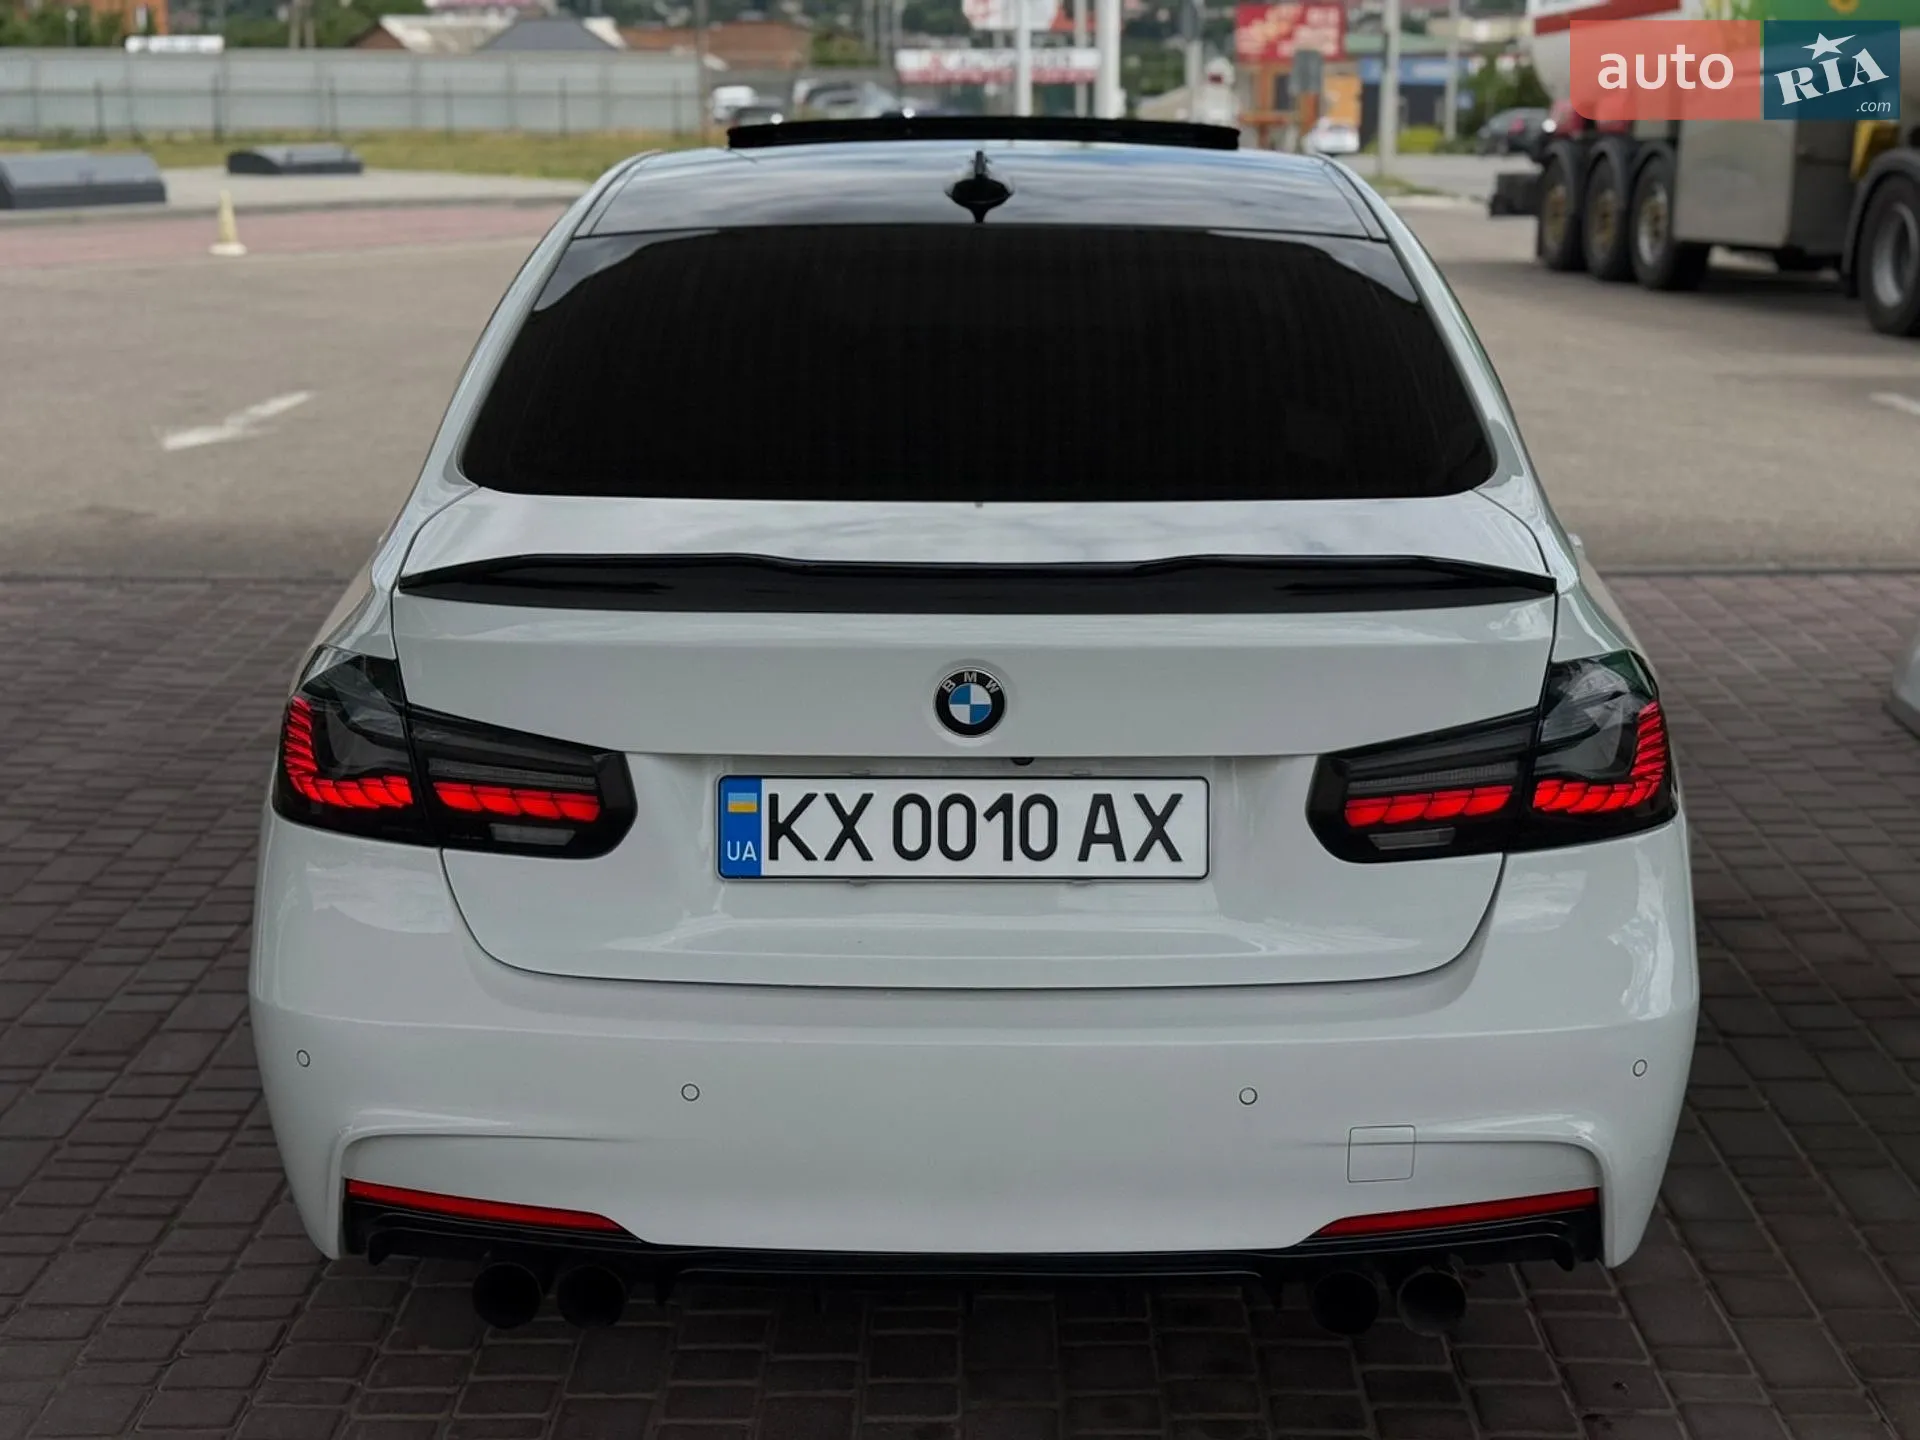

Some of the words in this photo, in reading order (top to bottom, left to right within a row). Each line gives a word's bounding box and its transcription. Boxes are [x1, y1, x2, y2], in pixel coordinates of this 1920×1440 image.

[941, 671, 1000, 694] BMW
[768, 793, 874, 862] KX
[892, 793, 1058, 862] 0010
[1077, 793, 1184, 862] AX
[727, 841, 757, 861] UA
